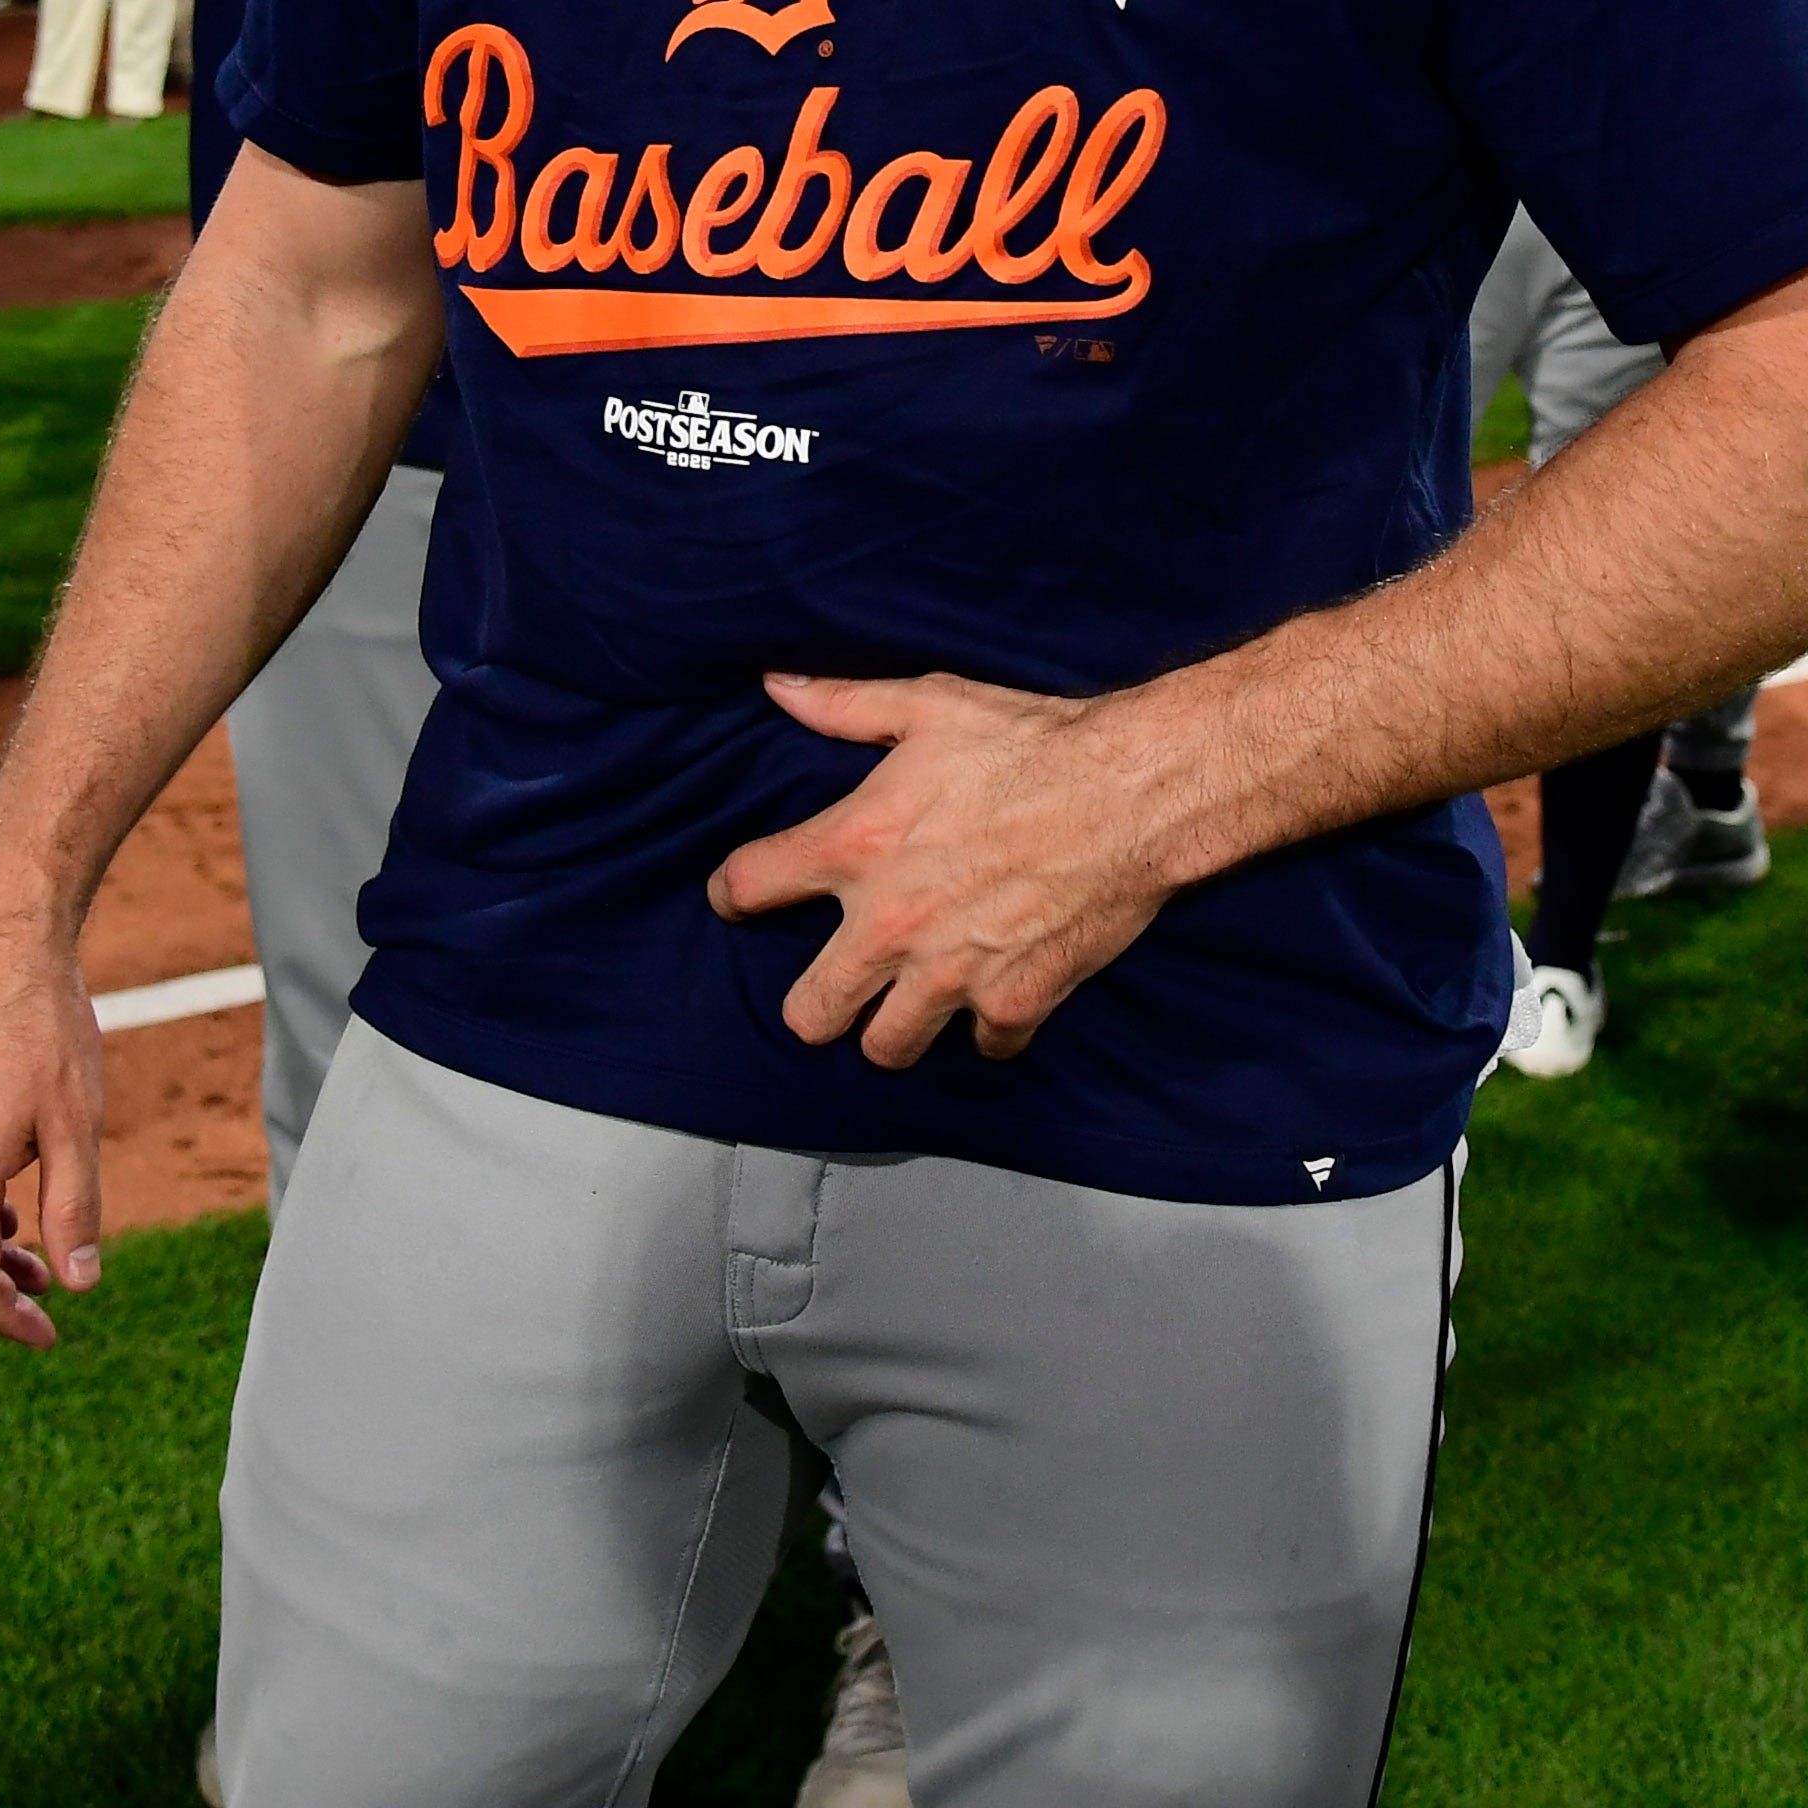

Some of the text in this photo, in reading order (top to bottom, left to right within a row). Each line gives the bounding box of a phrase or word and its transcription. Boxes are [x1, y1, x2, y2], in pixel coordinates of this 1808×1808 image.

[422, 21, 1168, 302] Baseball
[602, 395, 811, 465] POSTSEASON
[665, 450, 713, 472] 2025
